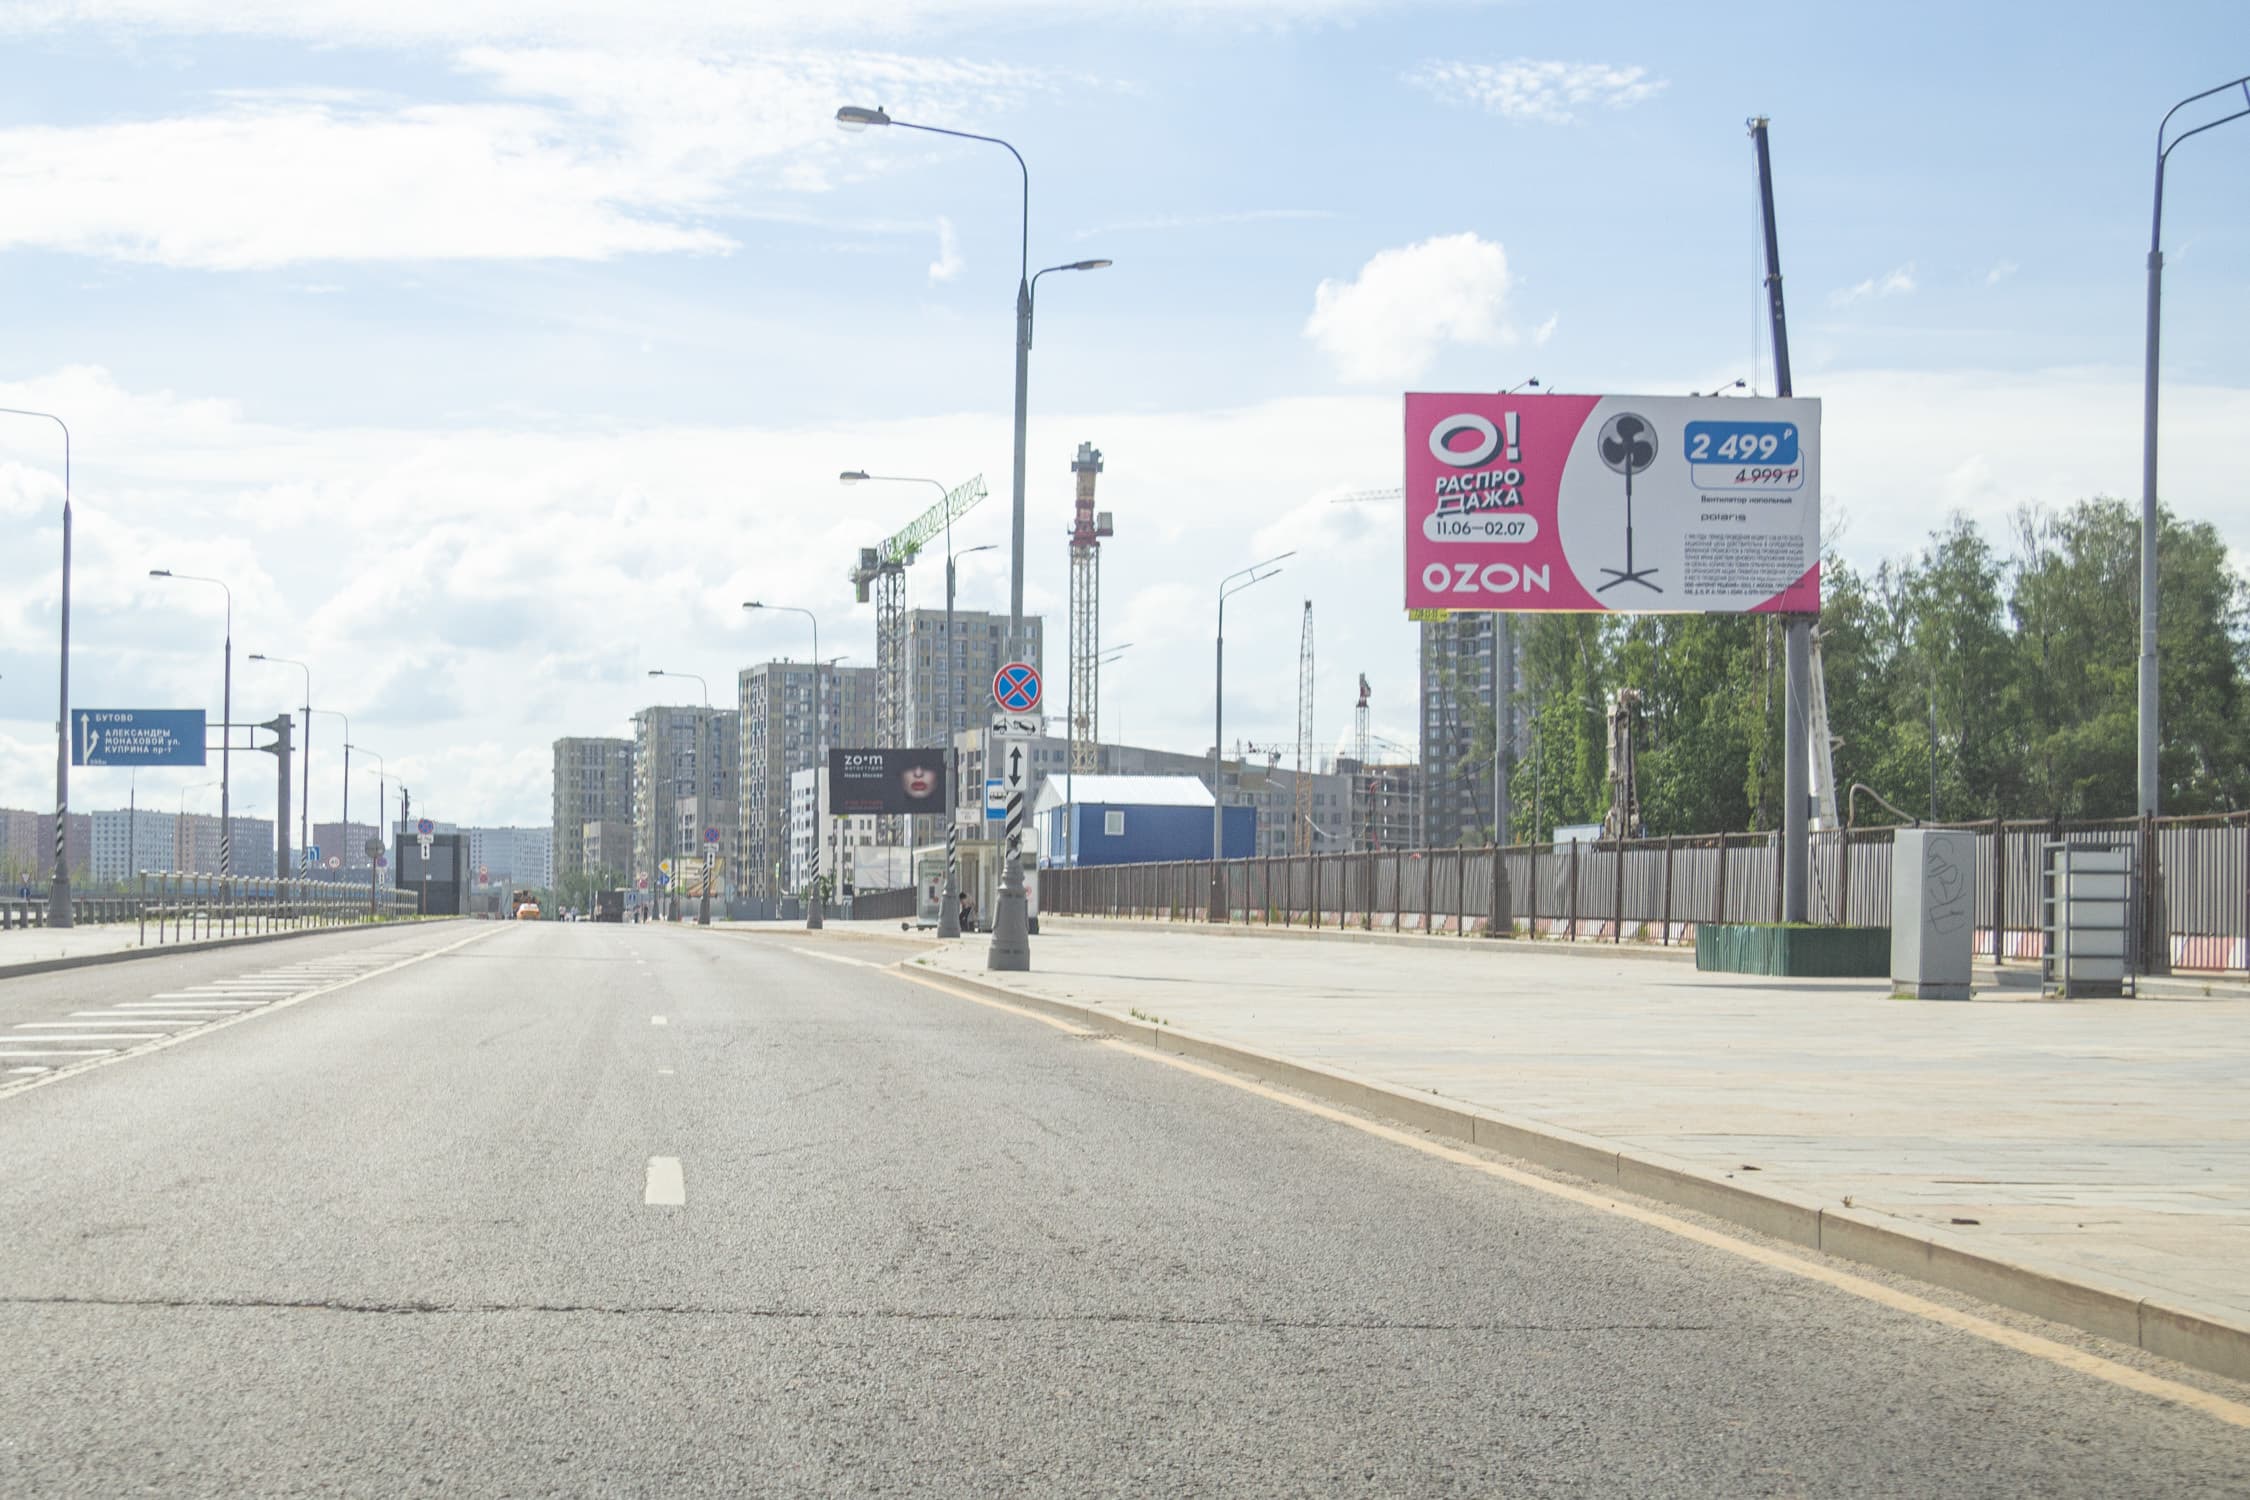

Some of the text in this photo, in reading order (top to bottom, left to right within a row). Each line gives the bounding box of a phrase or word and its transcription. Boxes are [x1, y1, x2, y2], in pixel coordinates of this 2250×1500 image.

[1690, 433, 1711, 459] 2
[1718, 433, 1778, 460] 499
[1435, 468, 1525, 495] РАСПРО
[1435, 488, 1521, 516] ДАЖА
[1422, 562, 1550, 593] OZON
[95, 713, 134, 723] БУТОВО
[105, 729, 171, 737] АЛЕКСАНДРЫ
[105, 737, 165, 745] МОНАХОВОЙ
[105, 746, 150, 754] КУПРИНА
